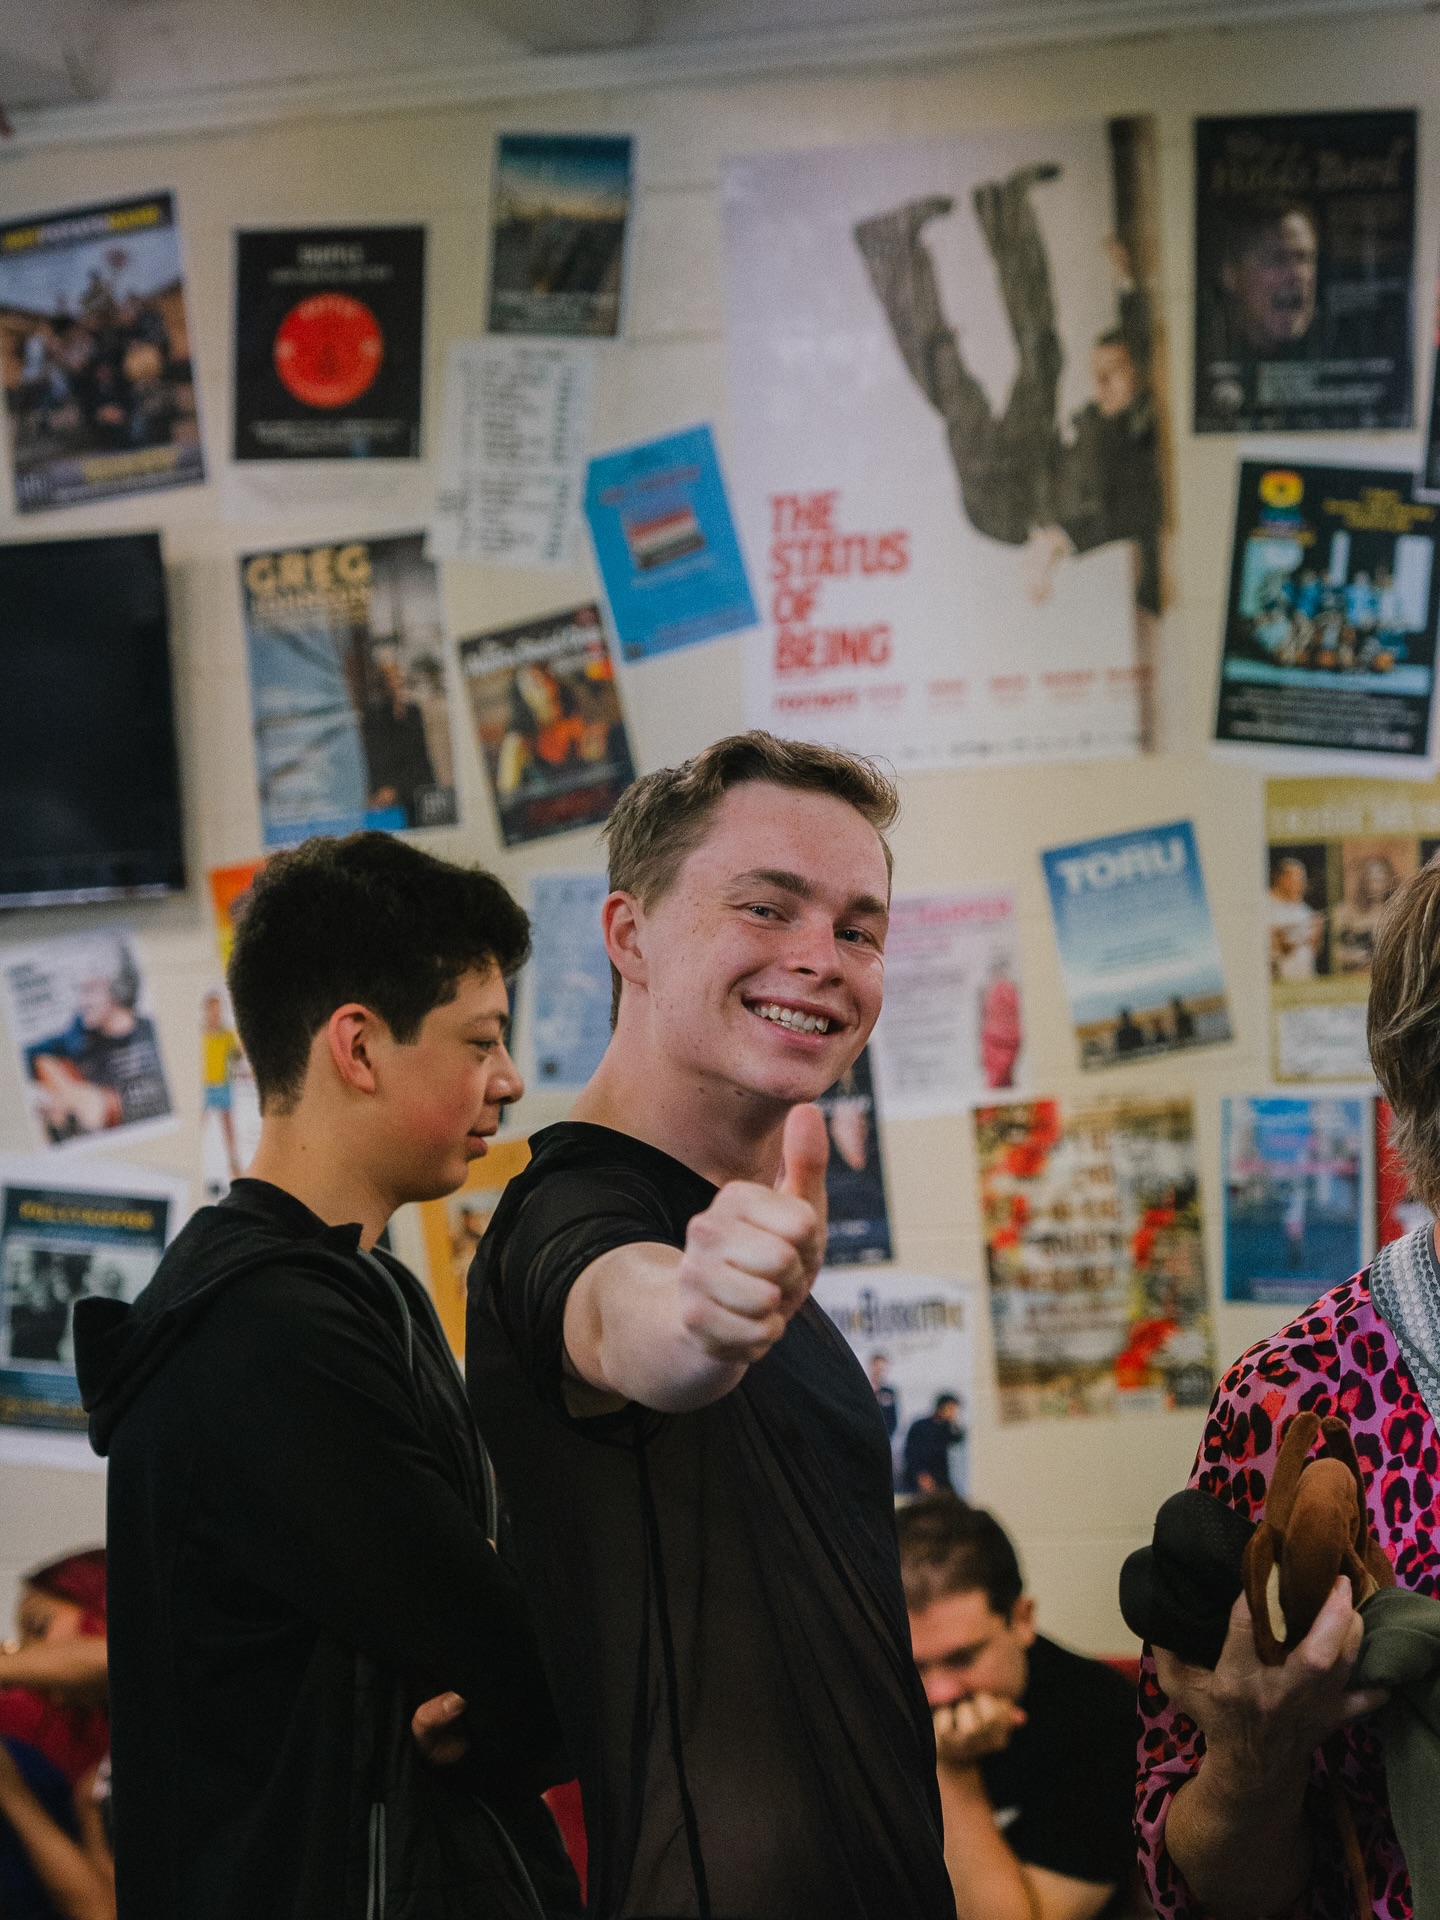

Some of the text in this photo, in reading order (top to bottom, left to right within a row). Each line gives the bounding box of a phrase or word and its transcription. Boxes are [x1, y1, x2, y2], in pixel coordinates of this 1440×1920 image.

[771, 487, 840, 533] THE
[248, 544, 372, 596] GREG
[771, 530, 910, 581] STATUS
[773, 580, 821, 626] OF
[776, 622, 891, 675] BEING
[1056, 838, 1186, 893] TORU
